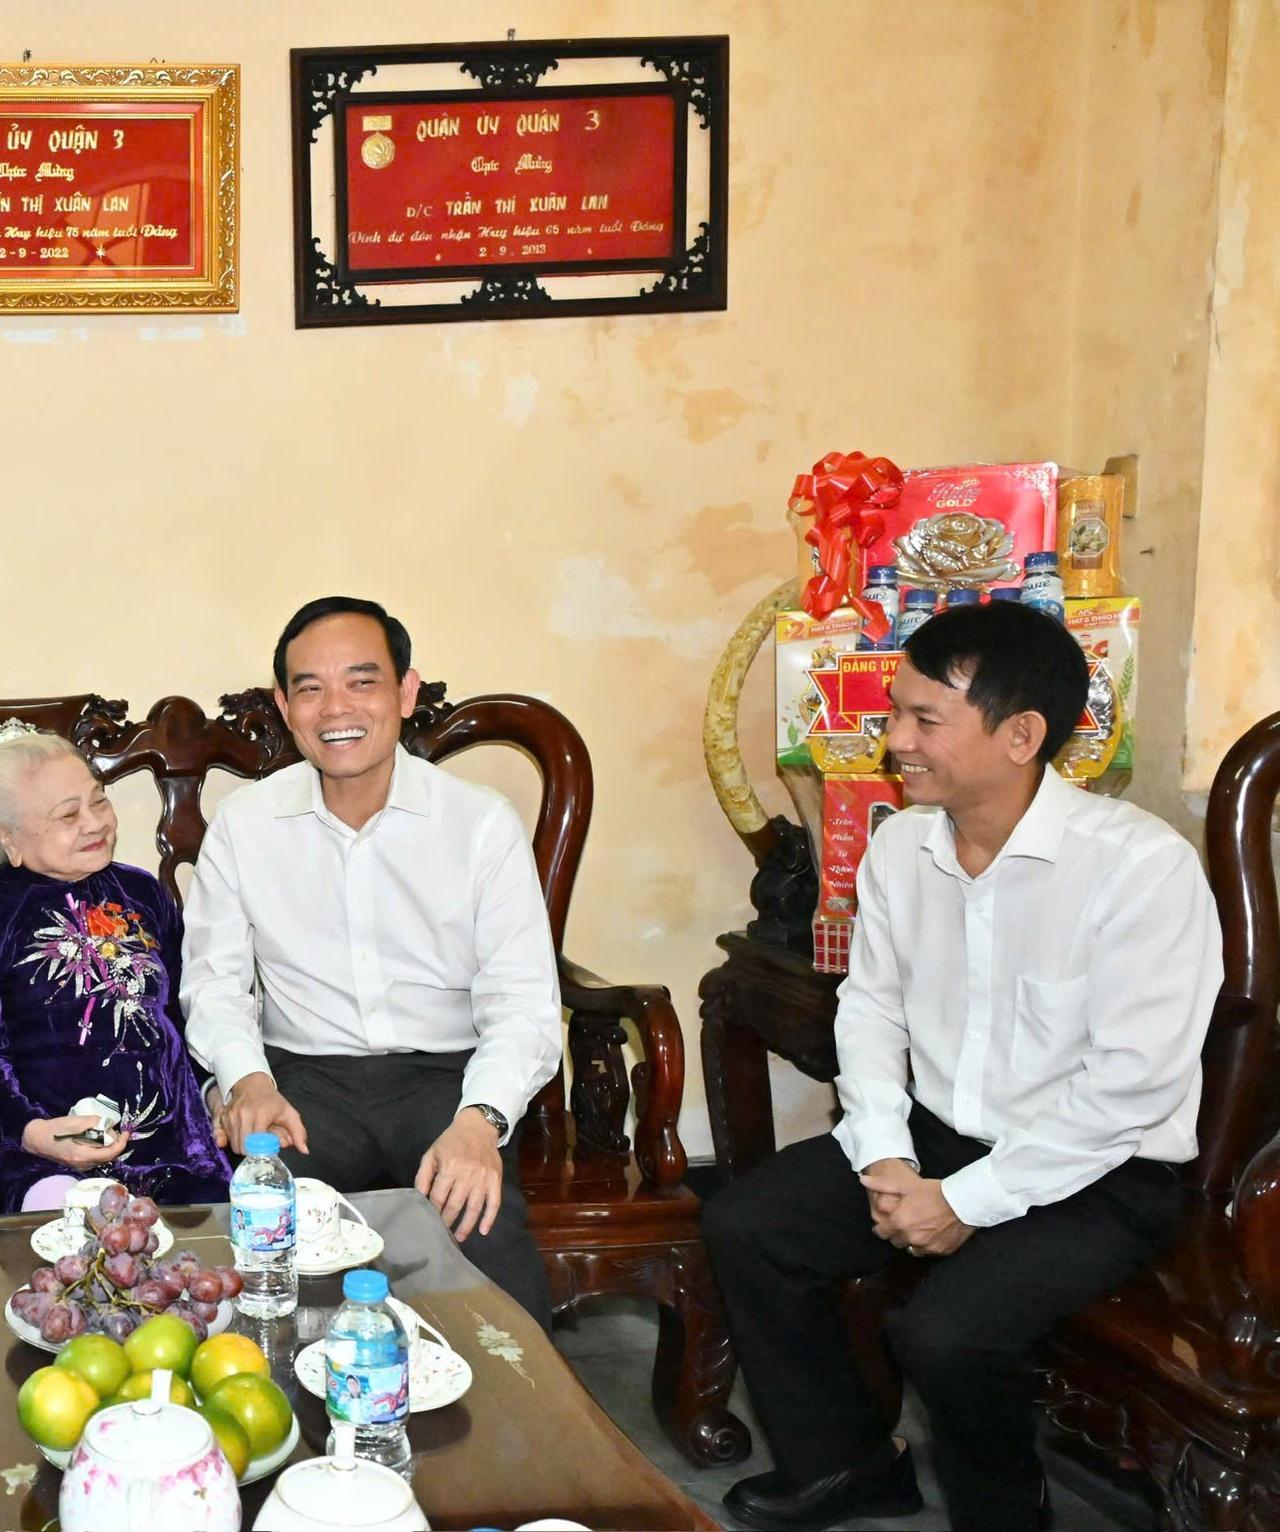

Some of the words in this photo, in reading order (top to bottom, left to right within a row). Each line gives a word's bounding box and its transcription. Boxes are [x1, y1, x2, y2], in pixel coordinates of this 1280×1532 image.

[417, 112, 460, 142] QUẬN
[585, 110, 601, 131] 3
[7, 123, 32, 150] ỦY
[48, 124, 98, 154] QUẬN
[113, 129, 124, 149] 3
[22, 194, 44, 214] THỊ
[54, 191, 91, 212] XUÂN
[103, 197, 129, 212] LAN
[446, 191, 481, 216] TRẦN
[529, 192, 566, 212] XUÂN
[581, 194, 608, 210] LAN
[66, 227, 79, 237] 75
[82, 227, 109, 237] năm
[112, 224, 137, 237] tuổi
[141, 224, 178, 239] Đảng
[546, 224, 559, 235] 65
[19, 248, 27, 258] 9
[40, 248, 70, 258] 2022
[479, 247, 487, 257] 2
[499, 246, 507, 256] 9
[522, 244, 546, 255] 2013
[936, 499, 972, 508] GOLD
